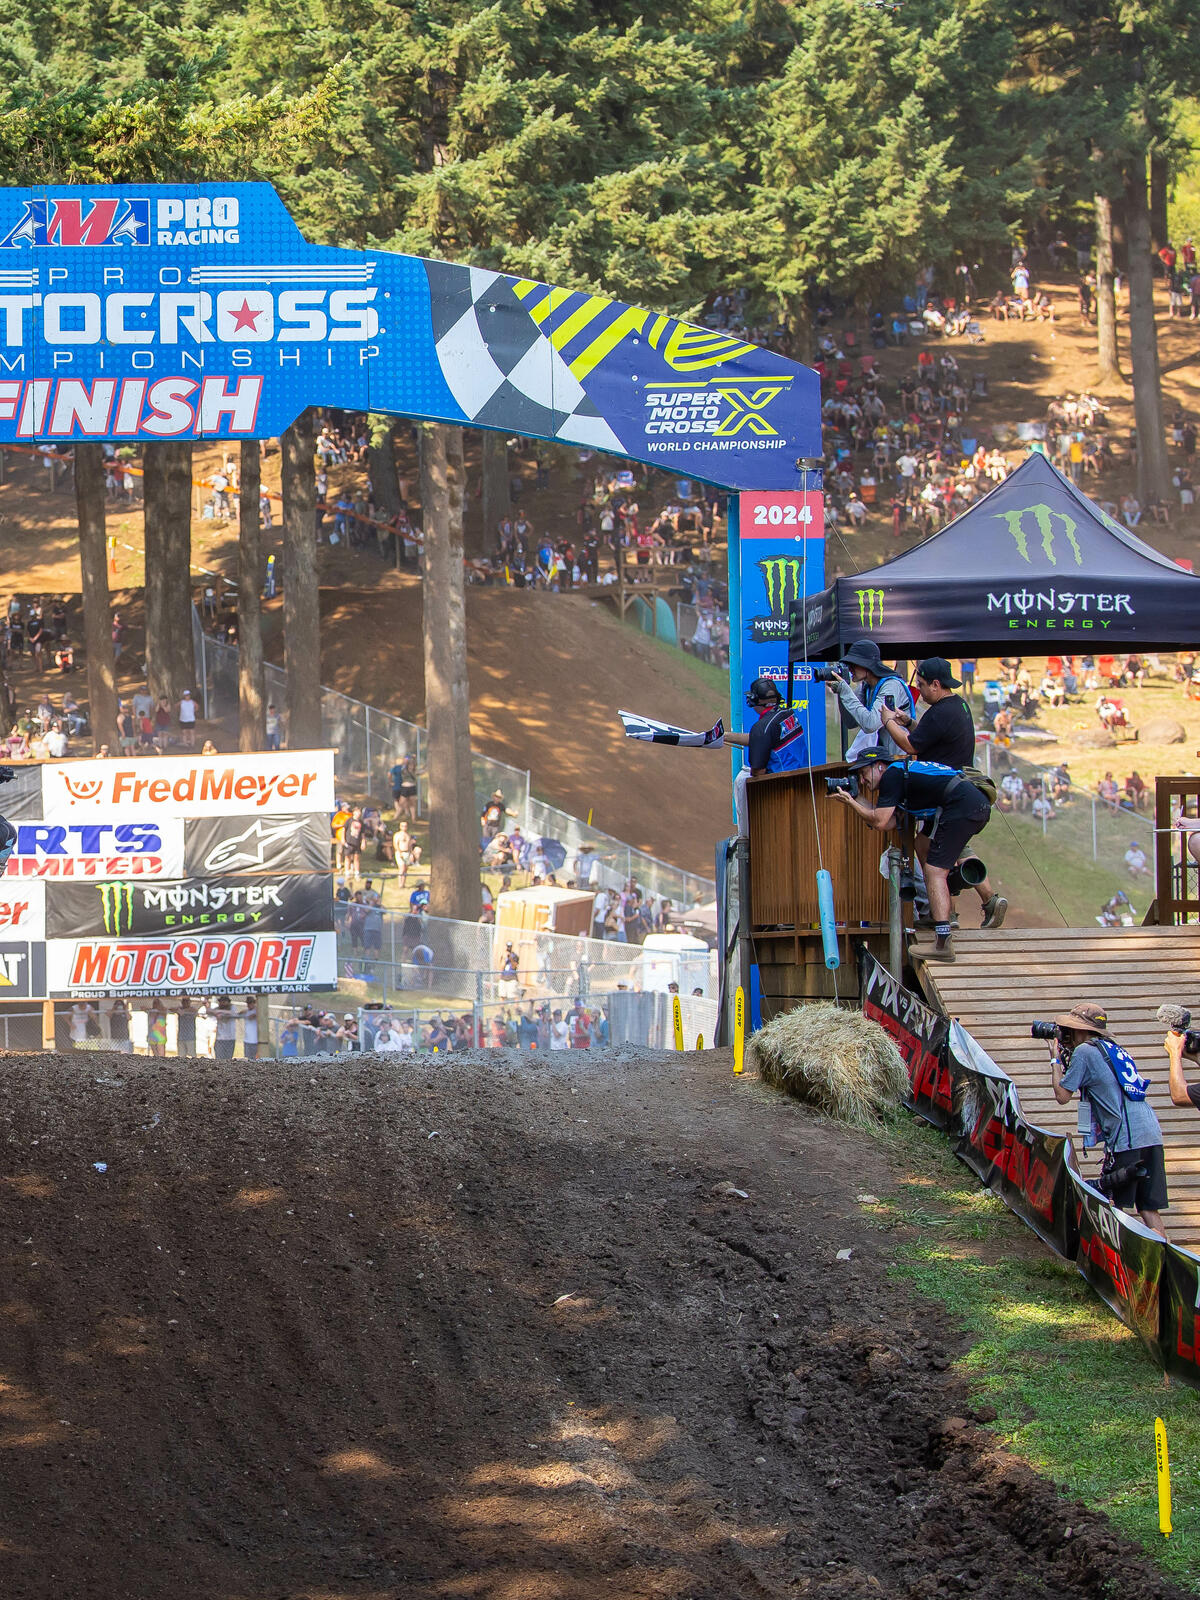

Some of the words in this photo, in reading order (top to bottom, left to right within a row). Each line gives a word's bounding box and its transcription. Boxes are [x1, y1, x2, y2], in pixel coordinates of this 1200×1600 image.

[157, 197, 240, 229] PRO
[157, 229, 240, 246] RACING
[49, 267, 182, 286] PRO
[644, 392, 723, 407] SUPER
[650, 406, 719, 420] MOTO
[644, 420, 721, 434] CROSS
[647, 442, 691, 452] WORLD
[693, 439, 787, 451] CHAMPIONSHIP
[753, 505, 813, 525] 2024
[986, 588, 1136, 616] MONSTER
[1008, 619, 1112, 629] ENERGY
[12, 823, 162, 855] RTS
[143, 884, 283, 913] MONSTER
[165, 912, 264, 925] ENERGY
[70, 936, 316, 986] MoToSPORT
[70, 990, 106, 999] PROUD
[109, 989, 168, 998] SUPPORTER
[170, 988, 184, 997] OF
[185, 986, 258, 996] WASHOUGAL
[261, 985, 279, 994] MX
[281, 983, 312, 992] PARK
[866, 961, 900, 1017] MX
[1156, 1432, 1164, 1473] ACERBIS
